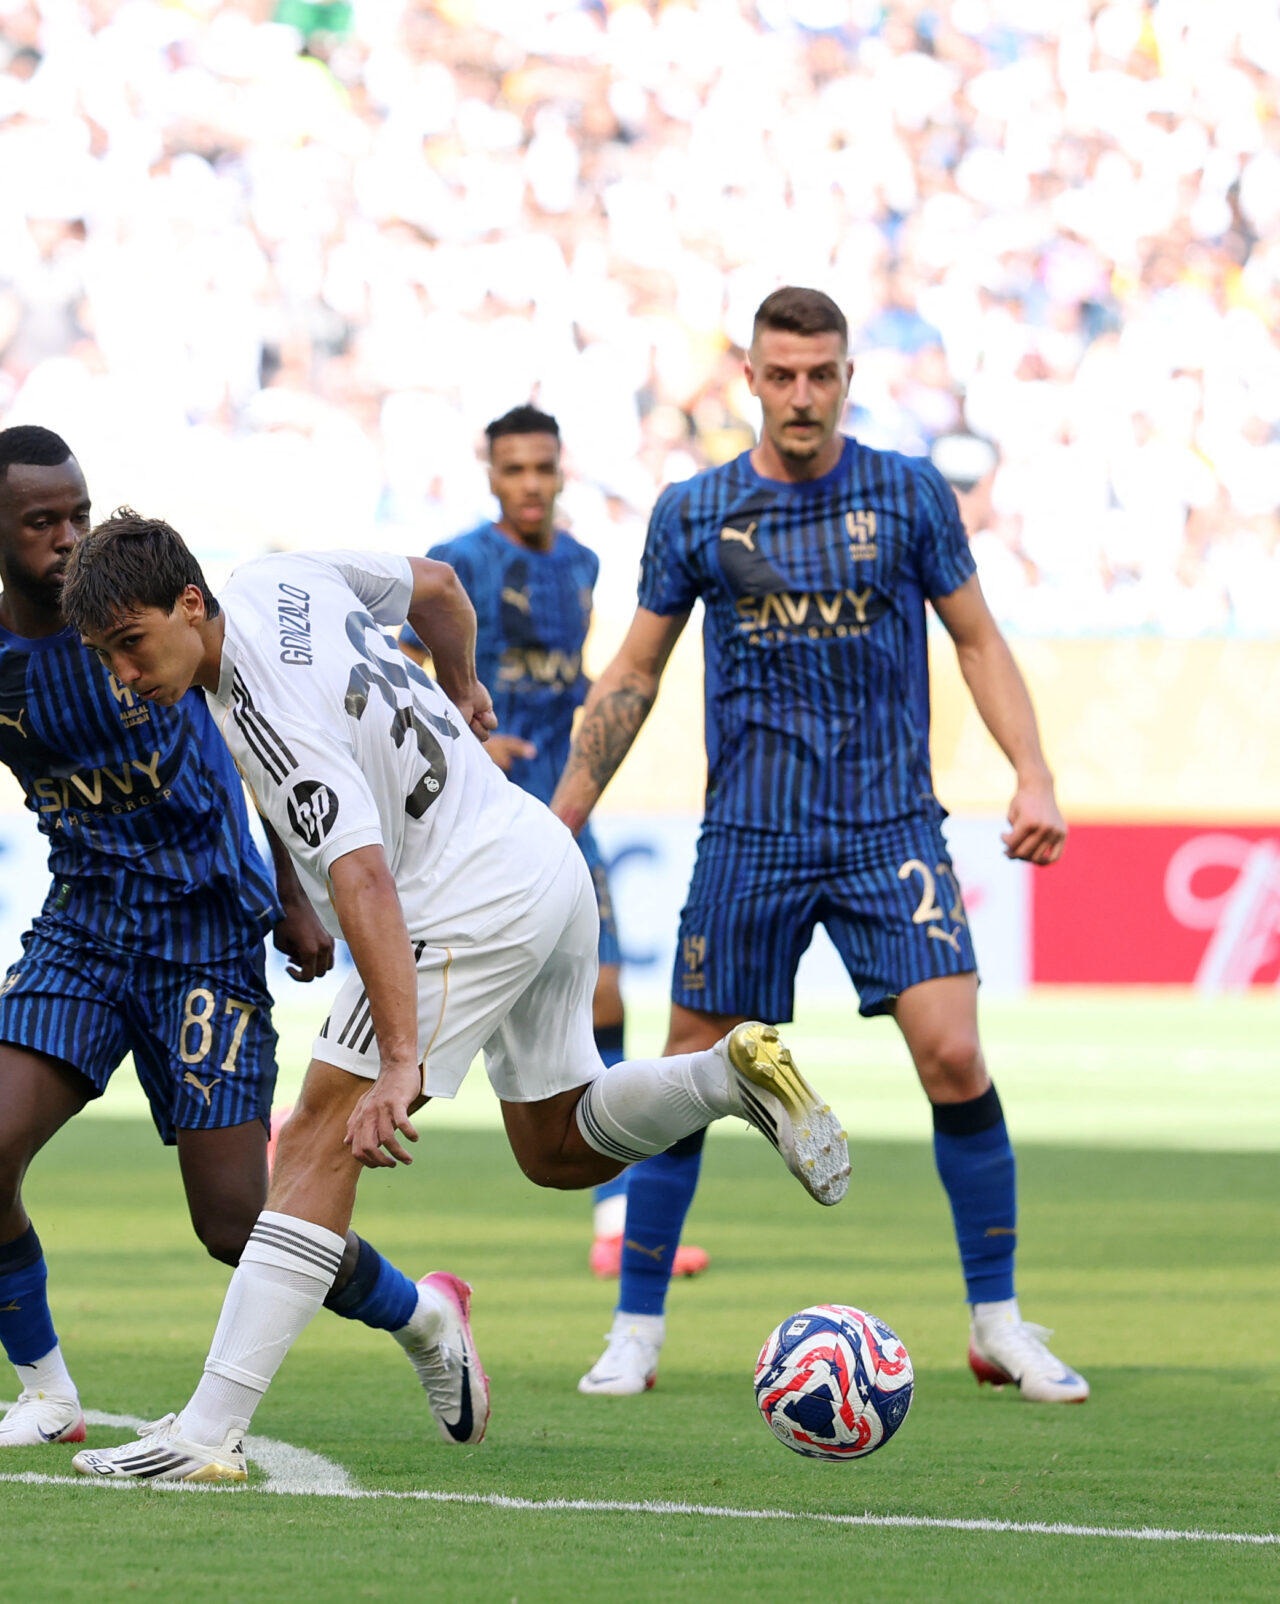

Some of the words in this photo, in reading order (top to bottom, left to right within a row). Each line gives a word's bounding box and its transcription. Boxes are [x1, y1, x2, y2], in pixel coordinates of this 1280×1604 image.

[278, 583, 313, 666] GONZALO
[736, 588, 872, 631] SAVVY
[33, 751, 161, 813] SAVVY
[55, 809, 105, 829] AMES
[112, 789, 172, 815] GROP
[288, 780, 339, 848] hp
[897, 859, 967, 925] 22
[180, 988, 256, 1072] 87
[82, 1453, 115, 1475] F50
